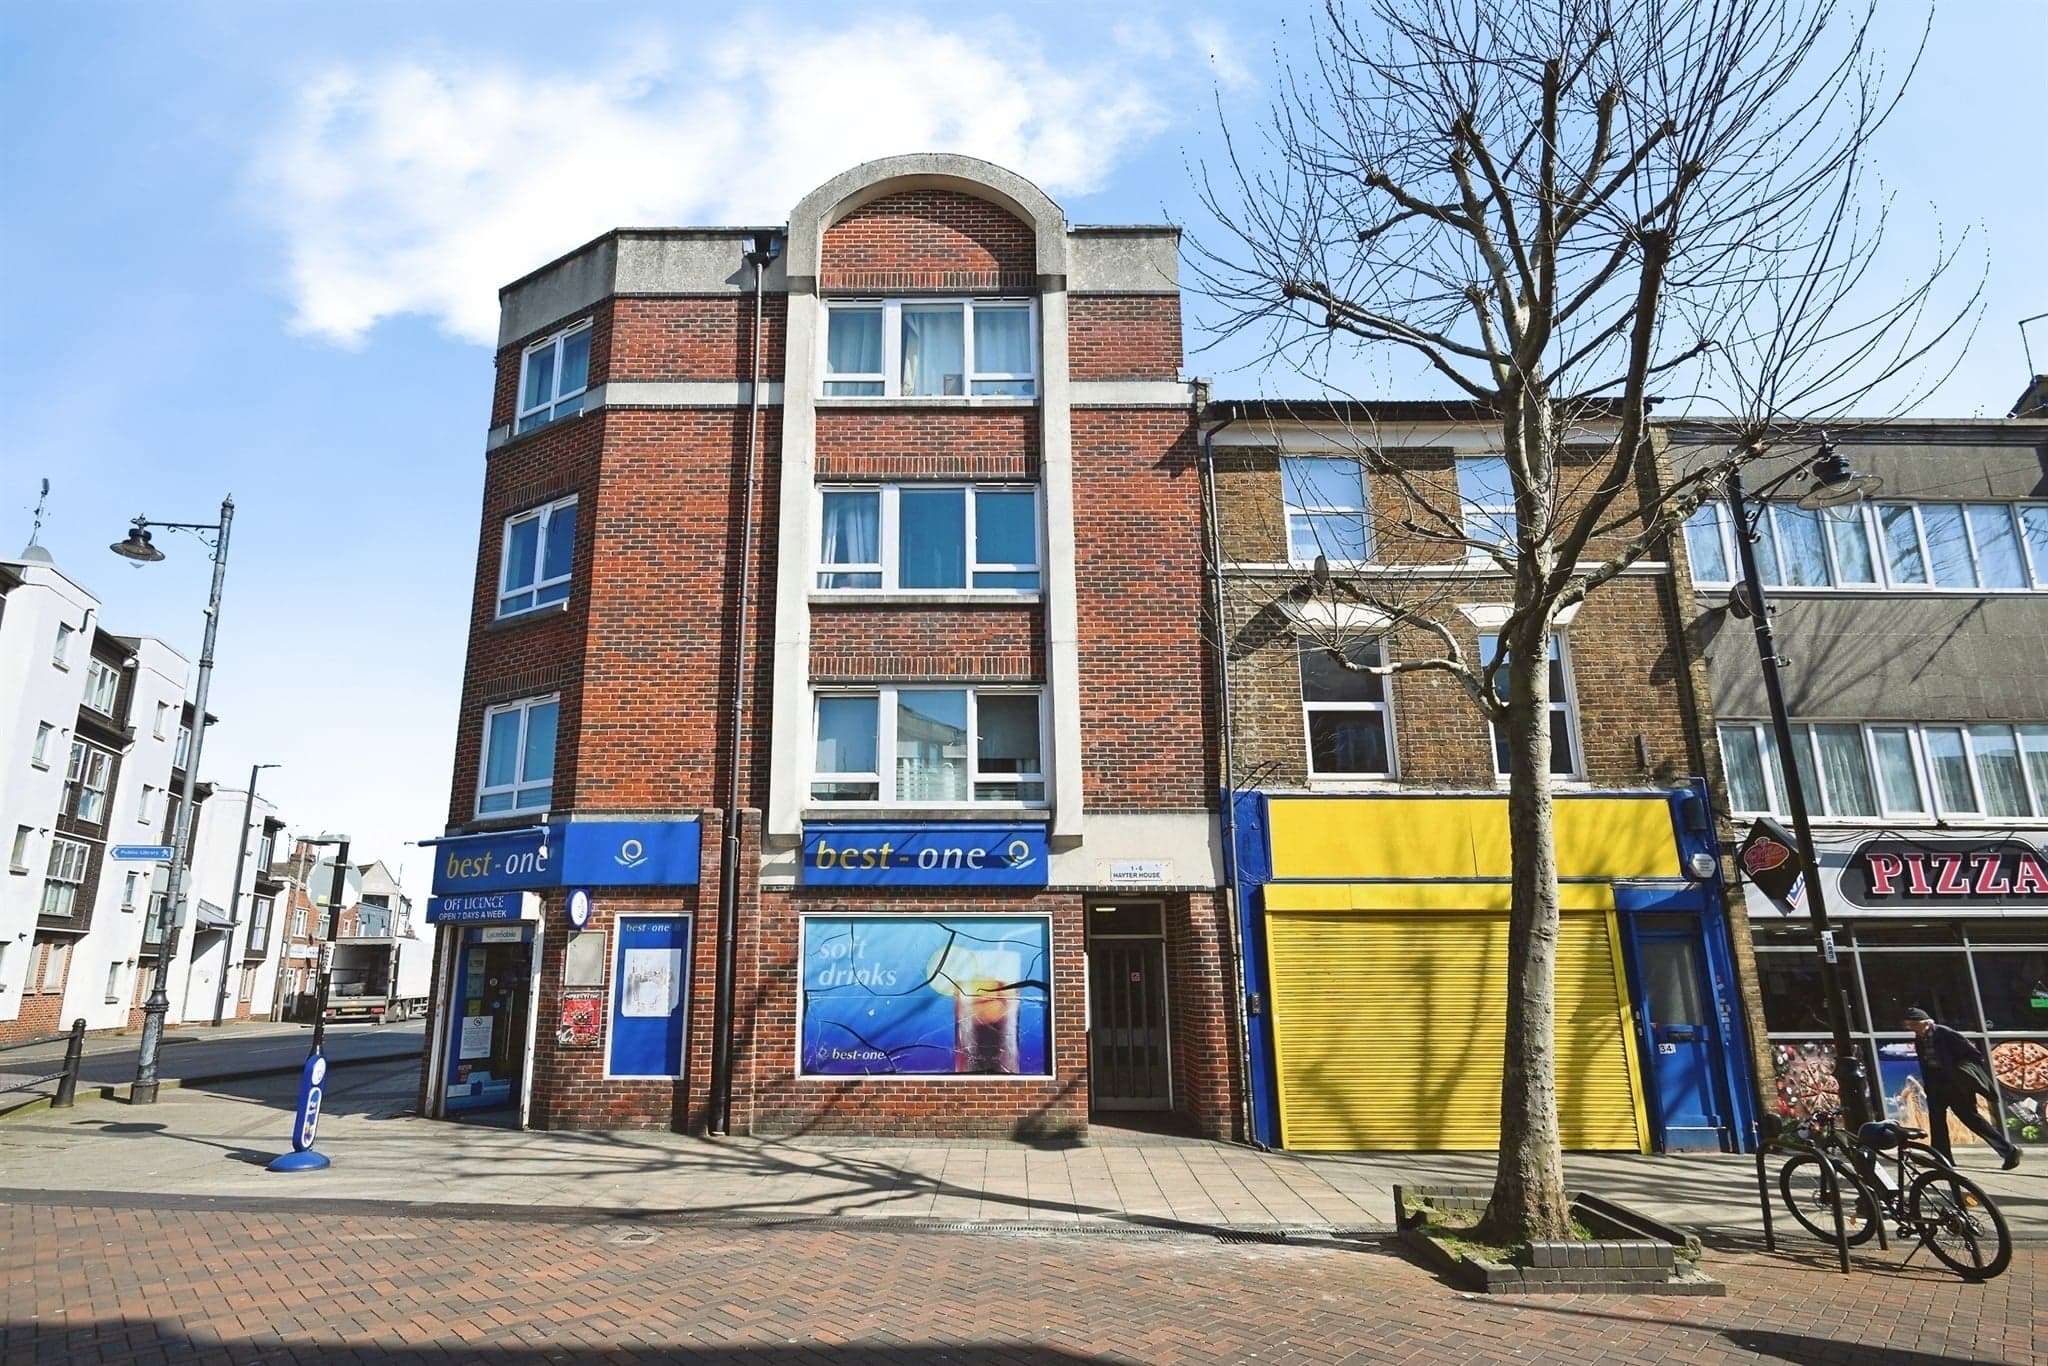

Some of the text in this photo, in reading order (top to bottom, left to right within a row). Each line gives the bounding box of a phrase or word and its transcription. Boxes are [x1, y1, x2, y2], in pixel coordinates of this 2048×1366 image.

[446, 851, 493, 879] best
[505, 852, 547, 875] one
[816, 840, 895, 870] best
[917, 846, 987, 870] one
[1866, 853, 2048, 894] PIZZA
[439, 912, 456, 920] OPEN
[463, 911, 480, 919] DAYS
[487, 910, 507, 918] WEEK
[444, 896, 504, 911] OFF LICENCE
[818, 962, 897, 987] drinks
